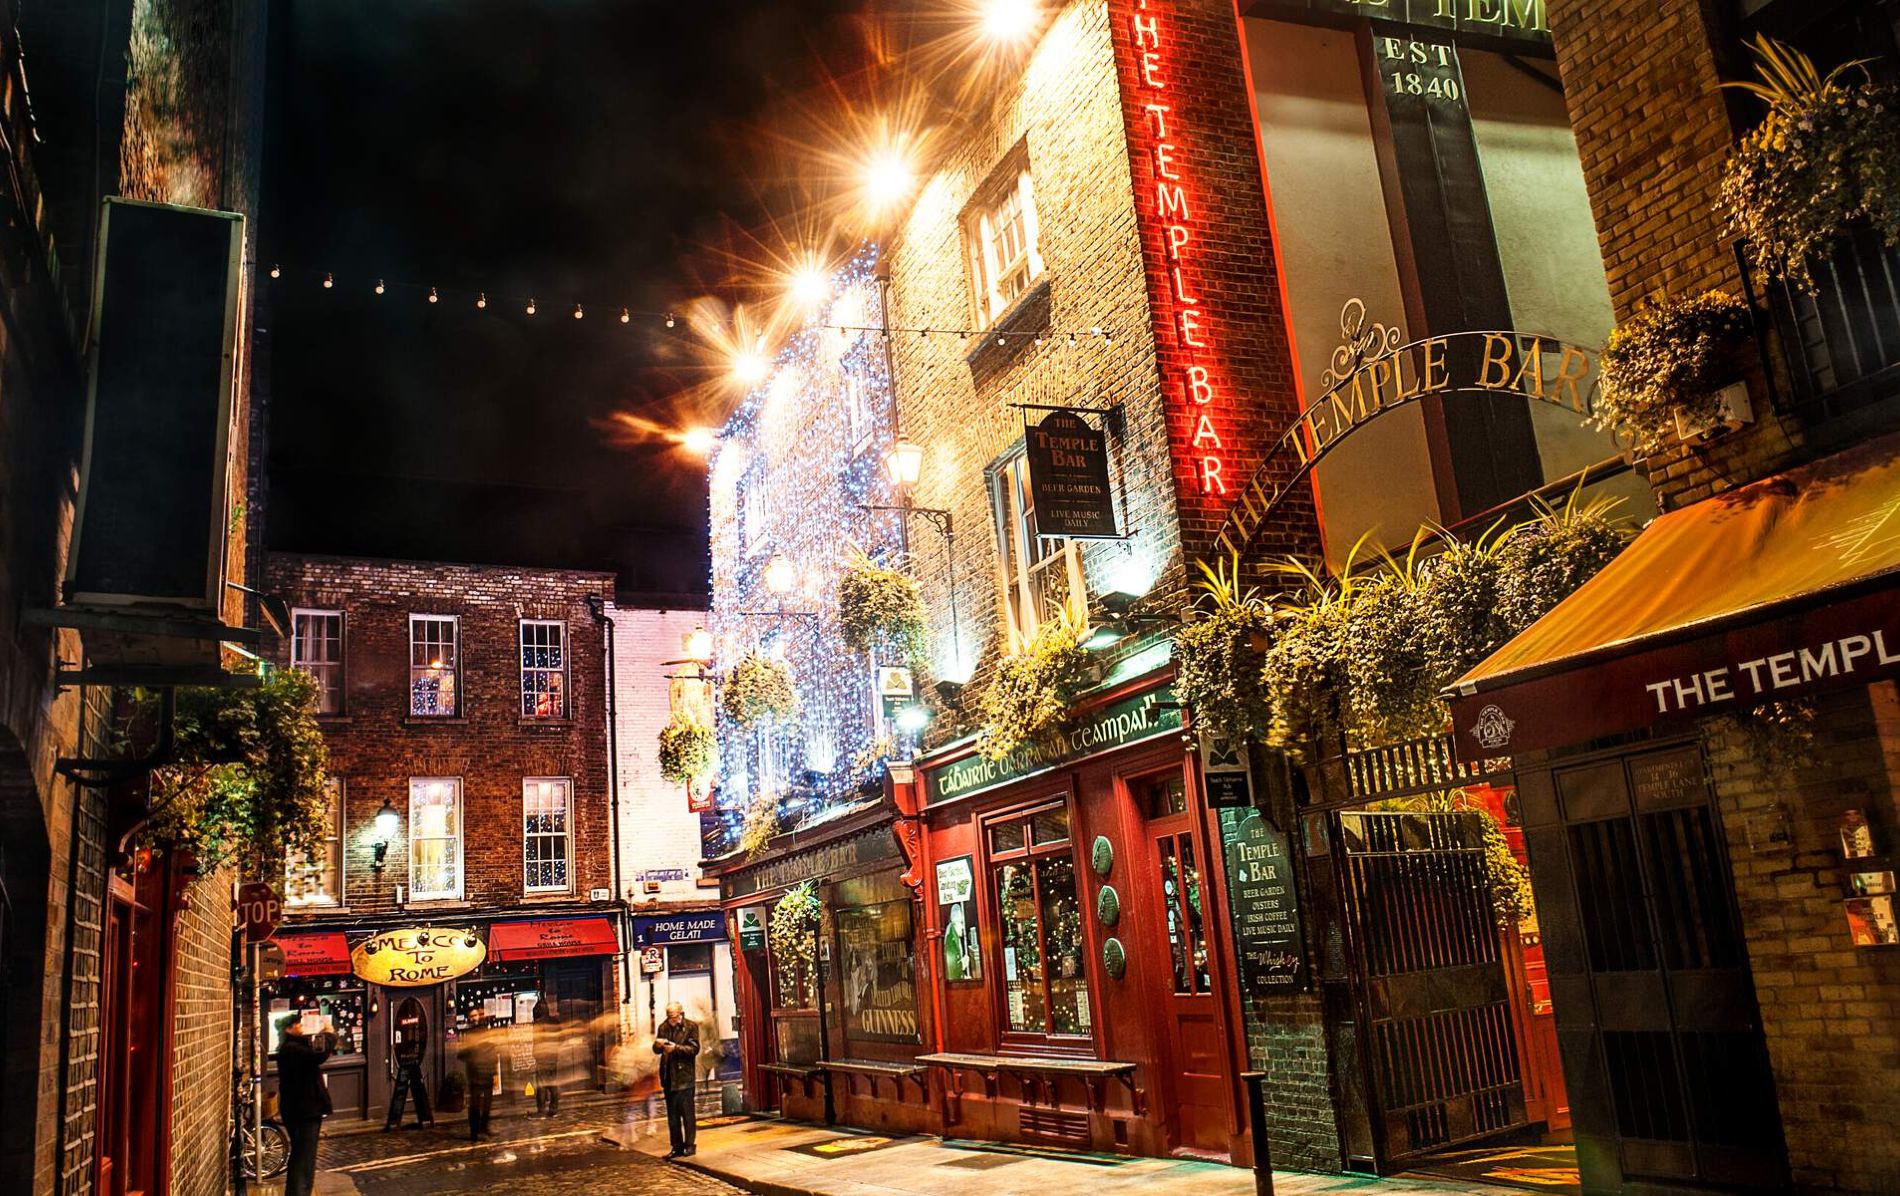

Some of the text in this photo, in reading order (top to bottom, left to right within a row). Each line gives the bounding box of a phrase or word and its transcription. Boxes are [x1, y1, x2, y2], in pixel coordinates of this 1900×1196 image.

[1384, 37, 1451, 67] EST
[1391, 72, 1459, 101] 1840
[1134, 0, 1226, 494] HE TEMPLE BAR
[1055, 417, 1076, 429] THE
[1035, 431, 1099, 452] TEMPLE
[1214, 332, 1590, 554] THE TEMPLE BAR
[1051, 448, 1087, 468] BAR
[1067, 482, 1101, 494] GARDEN
[1051, 509, 1100, 519] LIVE MUSIC
[1646, 629, 1900, 714] THE TEMPL
[1251, 828, 1264, 838] THE
[1237, 842, 1280, 862] TEMPLE
[1250, 862, 1276, 882] BAR
[1243, 885, 1285, 898] BEER GARDEN
[1252, 900, 1279, 910] OYSTERS
[1247, 911, 1287, 923] IRISH COFFEE
[655, 920, 716, 932] HOME MADE
[1243, 926, 1256, 936] LIVE
[1257, 924, 1277, 935] MUSIC
[637, 935, 644, 943] 1
[669, 930, 701, 940] GELATI
[388, 966, 454, 982] ROME
[1257, 974, 1293, 985] COLLECTION
[862, 1009, 917, 1036] GUINNESS
